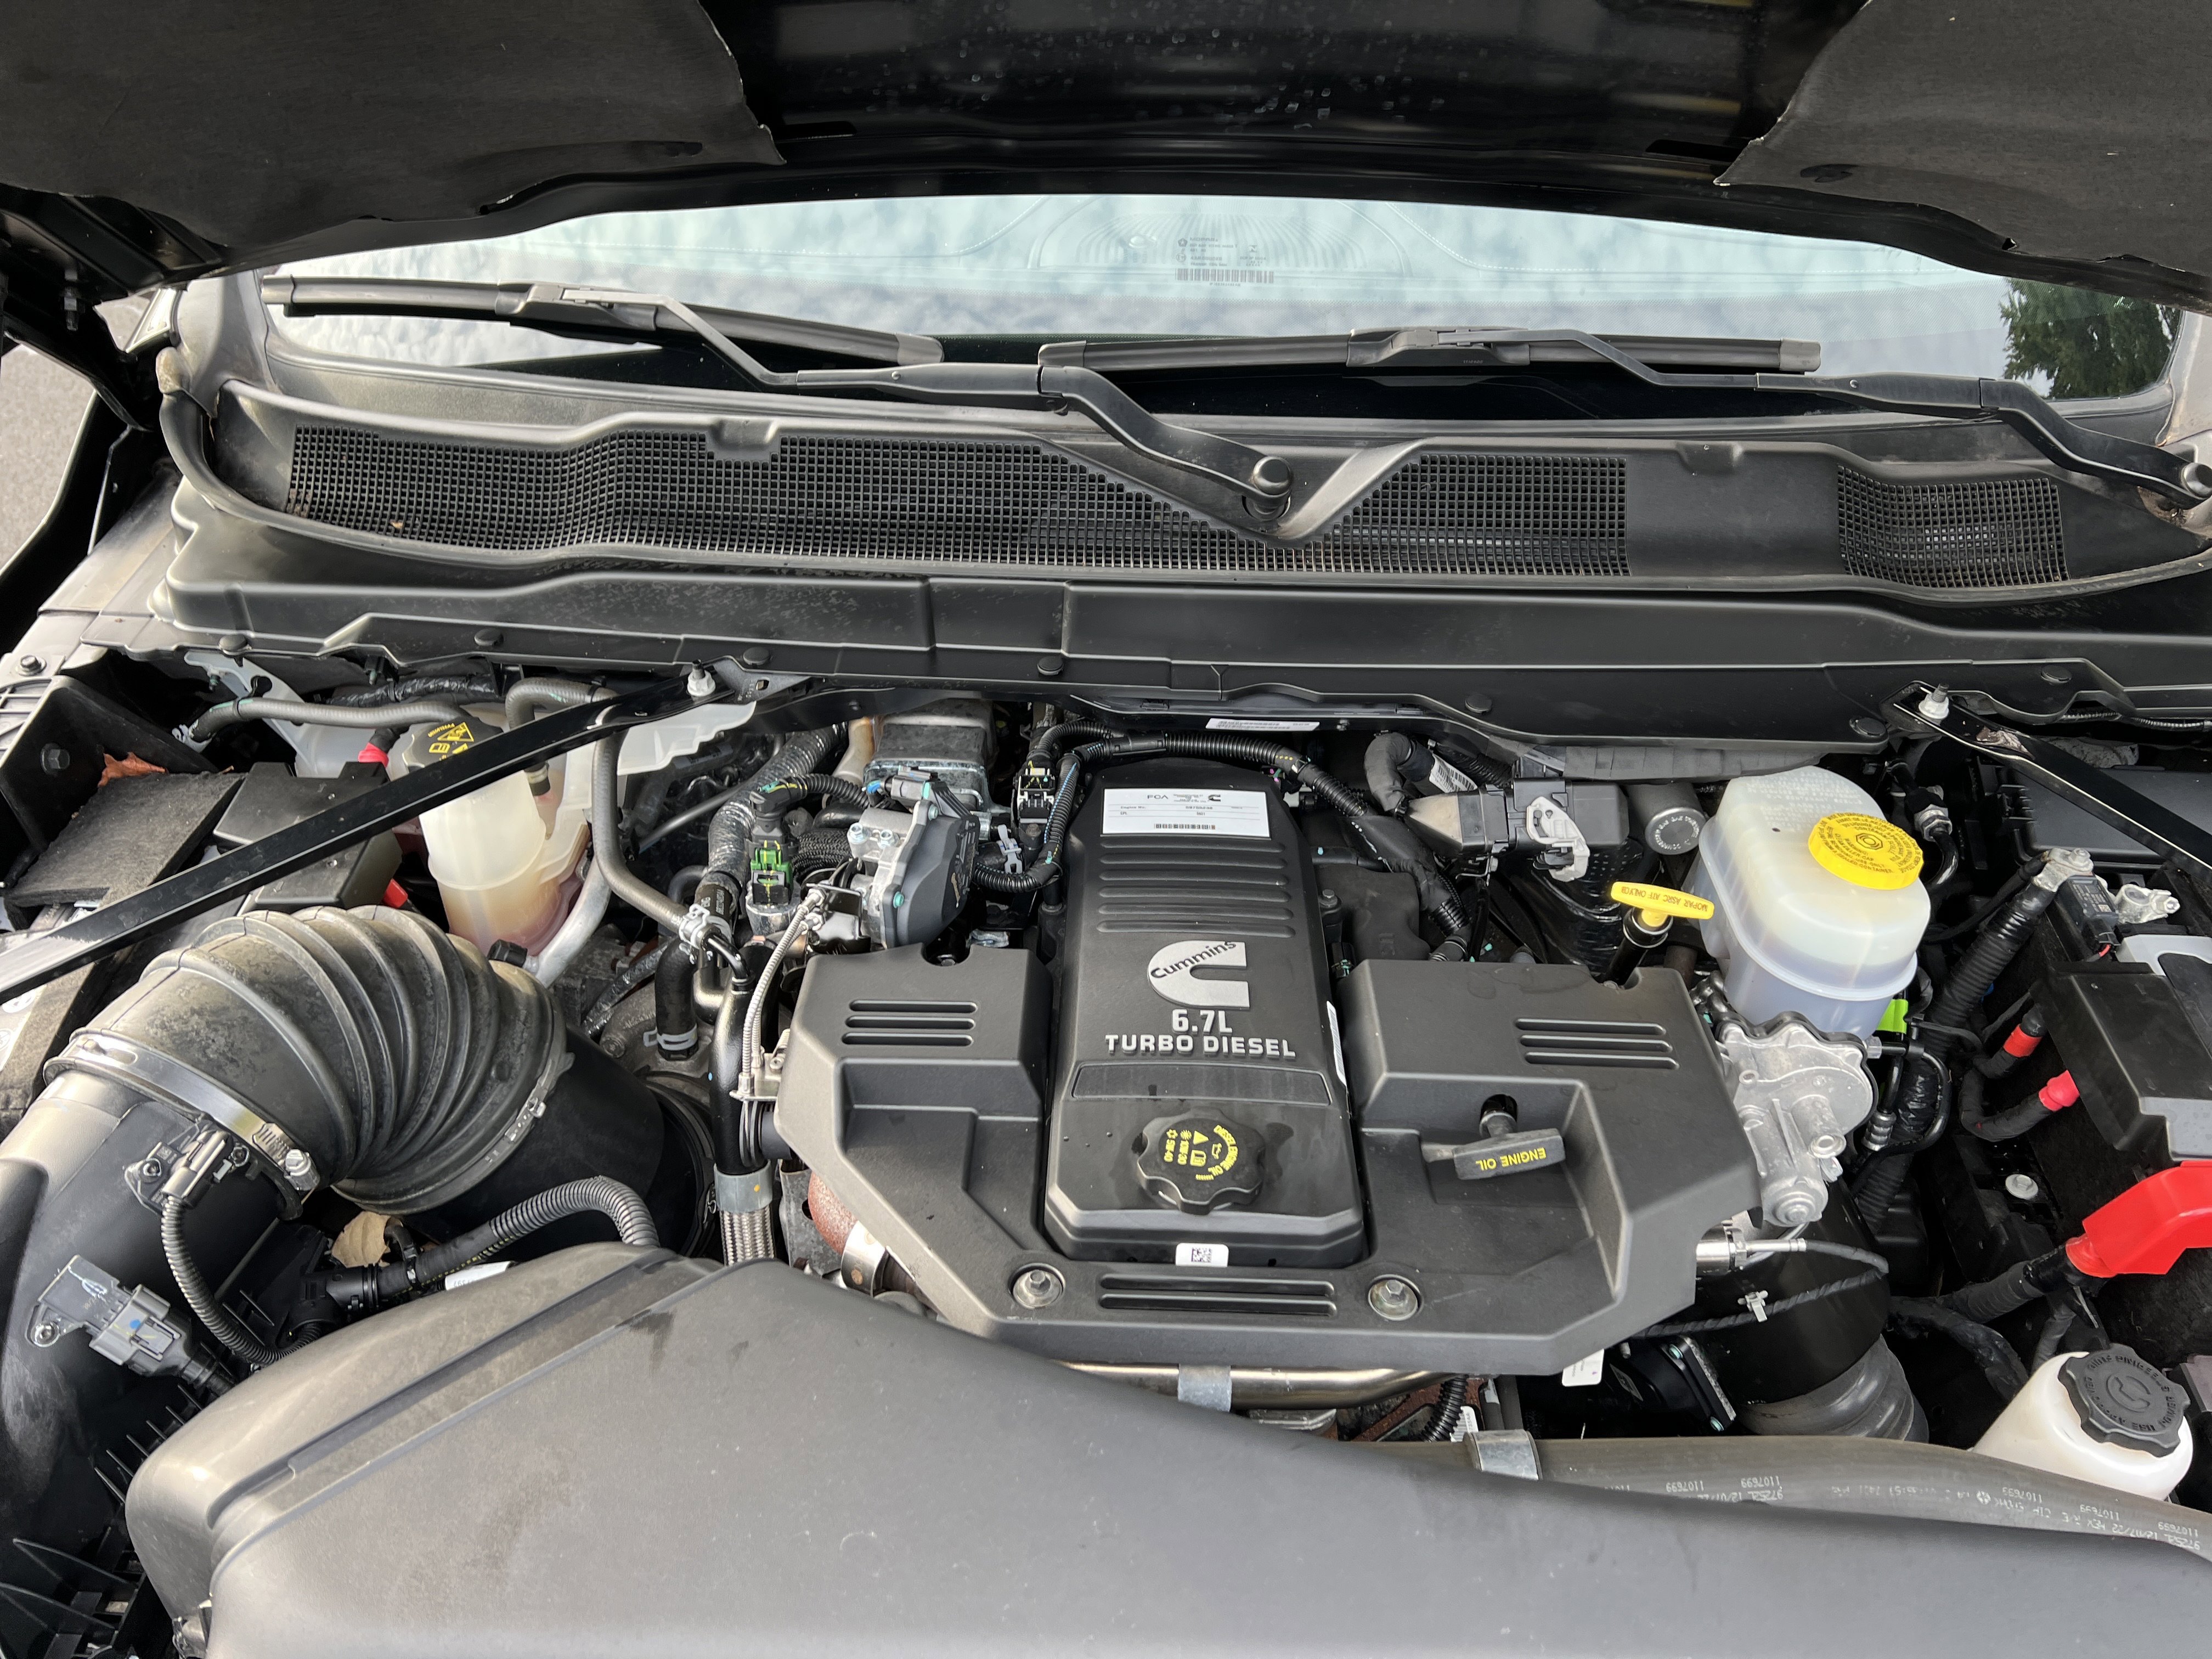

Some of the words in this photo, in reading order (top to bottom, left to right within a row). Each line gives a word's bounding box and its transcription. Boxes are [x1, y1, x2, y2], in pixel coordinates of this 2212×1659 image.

[1629, 888, 1646, 898] ONLY
[1647, 892, 1661, 900] ATF
[1663, 895, 1681, 905] ASRC
[1684, 899, 1708, 912] MOPAR
[1150, 940, 1236, 979] Cummins
[1172, 1009, 1233, 1035] 6.7L
[1105, 1034, 1194, 1054] TURBO
[1203, 1035, 1296, 1058] DIESEL
[1213, 1125, 1237, 1146] DIESEL
[1220, 1146, 1238, 1171] ENGINE
[1500, 1147, 1547, 1167] ENGINE
[1207, 1165, 1223, 1177] OIL
[1476, 1158, 1497, 1171] OIL
[2132, 1423, 2156, 1431] USE
[1666, 1480, 1705, 1493] 1107699
[1741, 1475, 1781, 1488] 1107699
